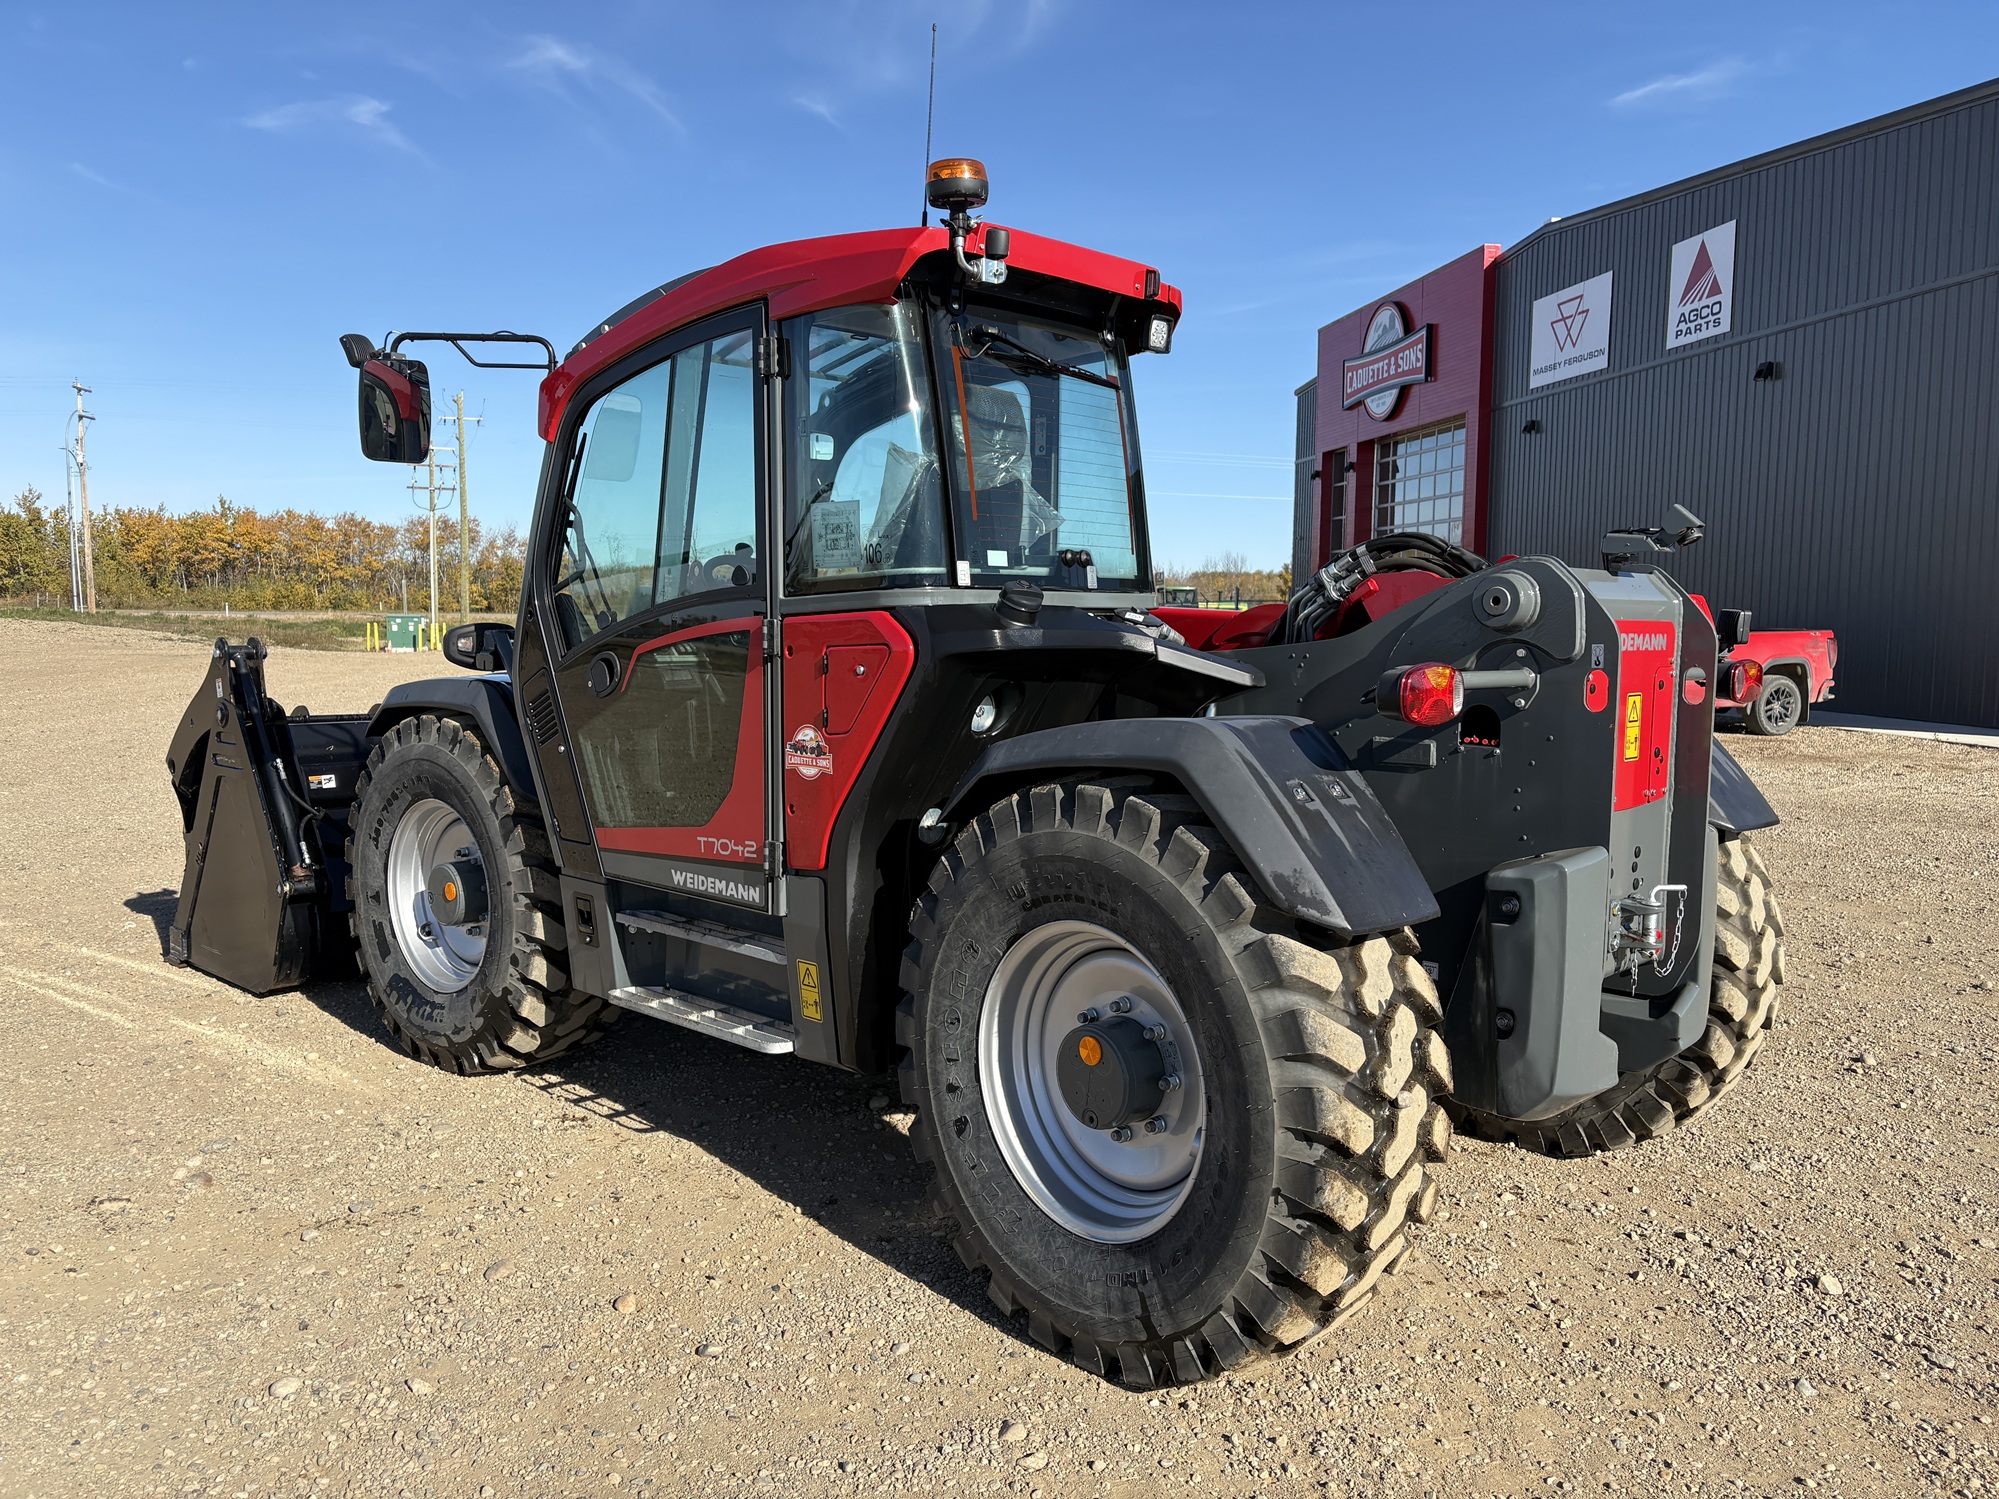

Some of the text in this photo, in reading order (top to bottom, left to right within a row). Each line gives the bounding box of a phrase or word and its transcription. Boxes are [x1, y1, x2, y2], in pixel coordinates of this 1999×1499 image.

[1676, 300, 1722, 328] AGCO
[1675, 317, 1721, 340] PARTS
[1389, 356, 1396, 376] &
[1397, 343, 1423, 373] SONS
[1532, 347, 1606, 377] MASSEY FERGUSON
[864, 542, 882, 564] 106
[1620, 633, 1667, 651] DEMANN
[817, 759, 830, 768] SONS
[697, 836, 757, 858] T7042
[671, 869, 760, 903] WEIDEMANN
